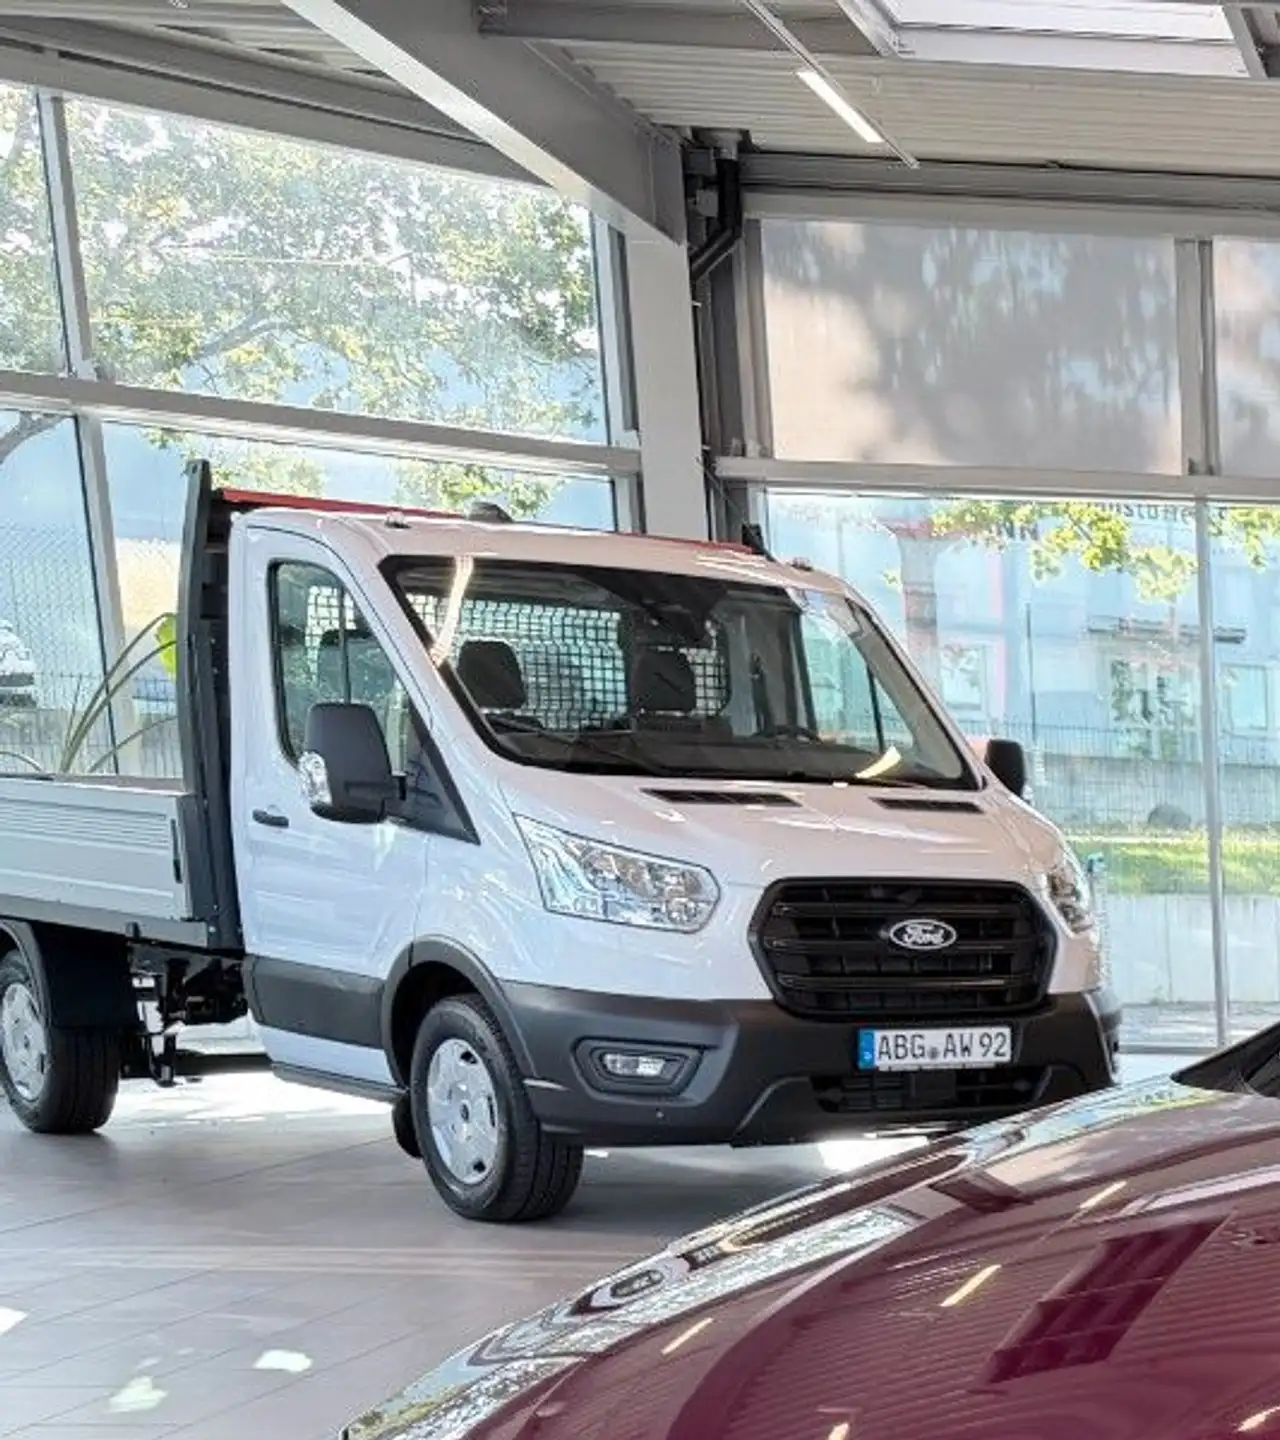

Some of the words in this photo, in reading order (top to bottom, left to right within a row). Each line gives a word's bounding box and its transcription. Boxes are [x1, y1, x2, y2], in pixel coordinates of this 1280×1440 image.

[879, 1034, 926, 1060] ABG
[943, 1033, 974, 1058] AW
[979, 1031, 1007, 1057] 92
